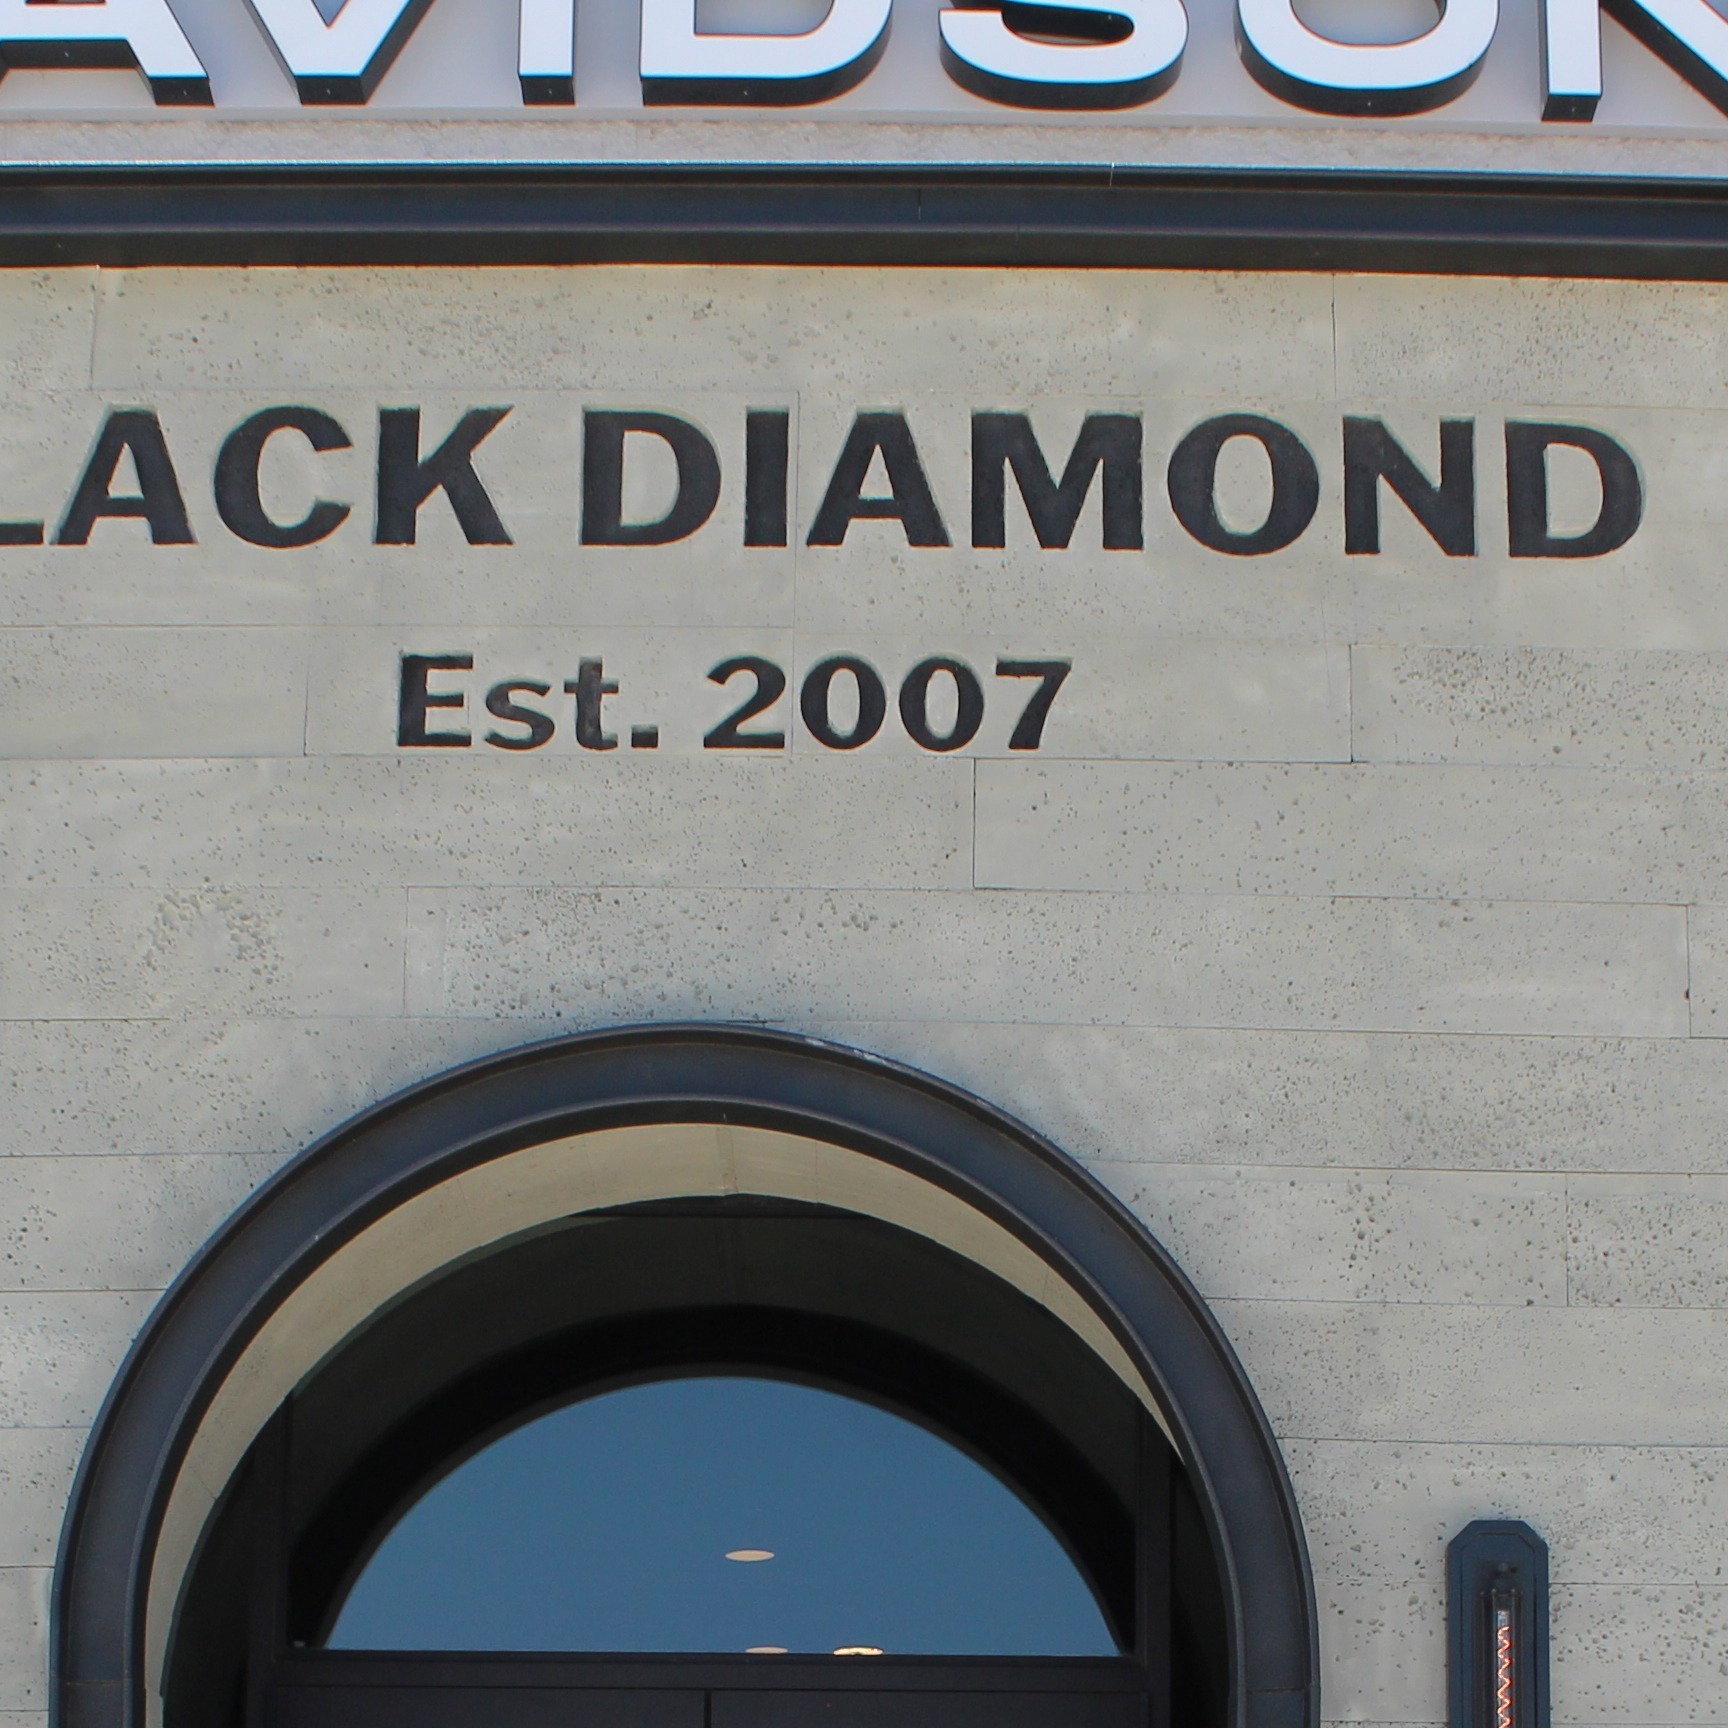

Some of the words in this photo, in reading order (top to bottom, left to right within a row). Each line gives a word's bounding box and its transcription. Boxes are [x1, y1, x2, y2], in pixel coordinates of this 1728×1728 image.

[577, 409, 1644, 561] DIAMOND
[395, 652, 660, 752] Est.
[701, 655, 1074, 753] 2007
